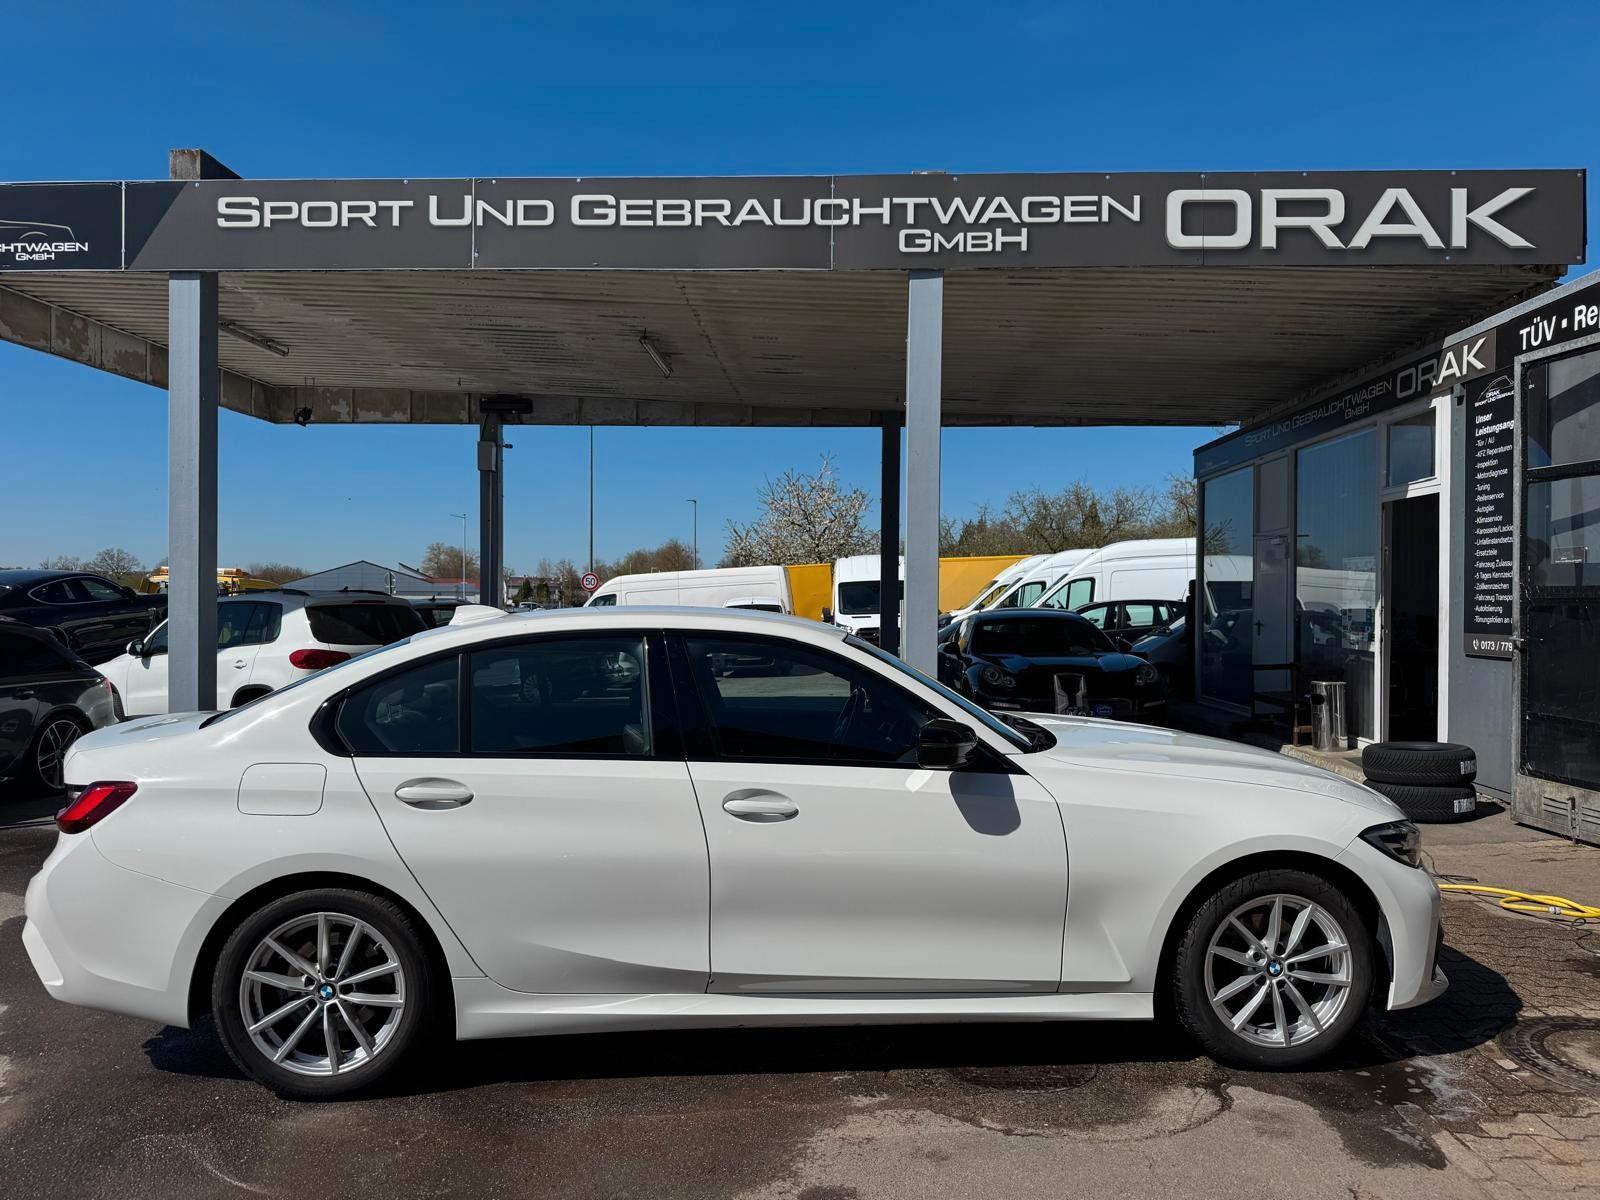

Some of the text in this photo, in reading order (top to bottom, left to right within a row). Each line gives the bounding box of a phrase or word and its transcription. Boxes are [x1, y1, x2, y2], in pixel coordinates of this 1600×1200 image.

[217, 194, 1140, 228] SPORT UND GEBRAUCHTWAGEN
[1166, 187, 1536, 249] ORAK
[0, 242, 88, 252] HTWAGEN
[1519, 305, 1600, 350] TÜV Re
[1396, 337, 1487, 399] ORAK
[1475, 413, 1493, 424] Unser
[585, 577, 596, 586] 50
[1480, 640, 1495, 650] 0173
[1500, 642, 1513, 652] 779
